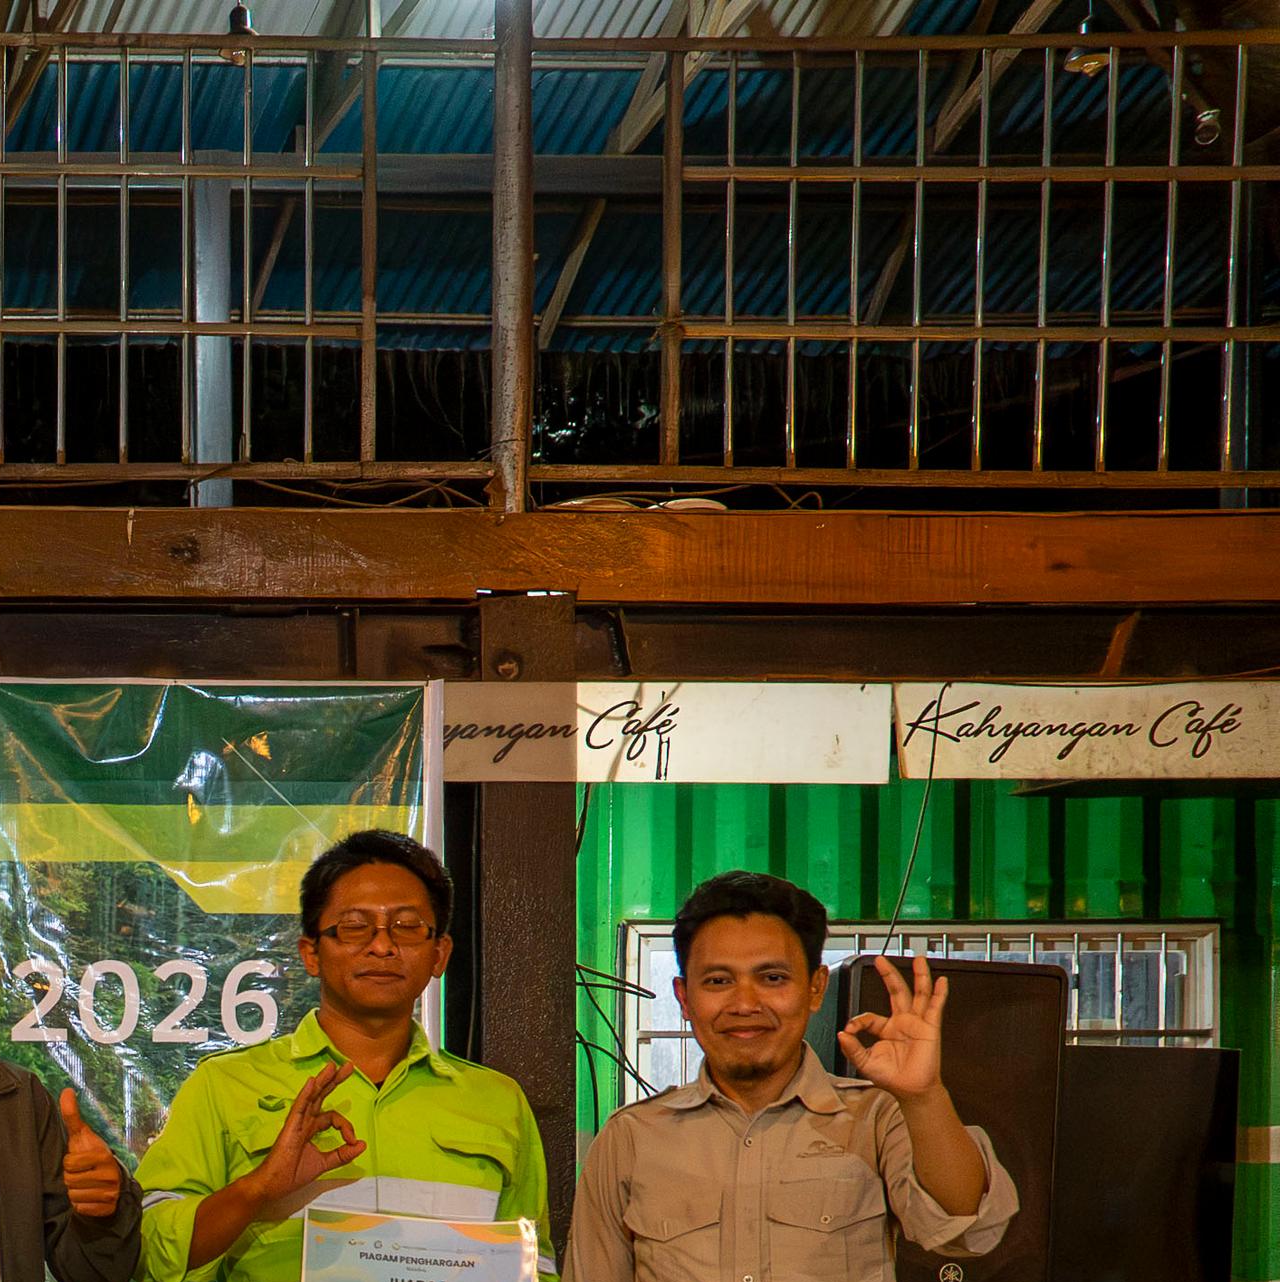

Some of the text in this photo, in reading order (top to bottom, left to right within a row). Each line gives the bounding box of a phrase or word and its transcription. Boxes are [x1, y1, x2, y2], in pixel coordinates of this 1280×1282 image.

[442, 701, 679, 763] yangan Café
[903, 700, 1242, 763] Kahyangan Café
[10, 959, 279, 1044] 2026
[359, 1251, 475, 1269] PIAGAM PENGHARGAAN
